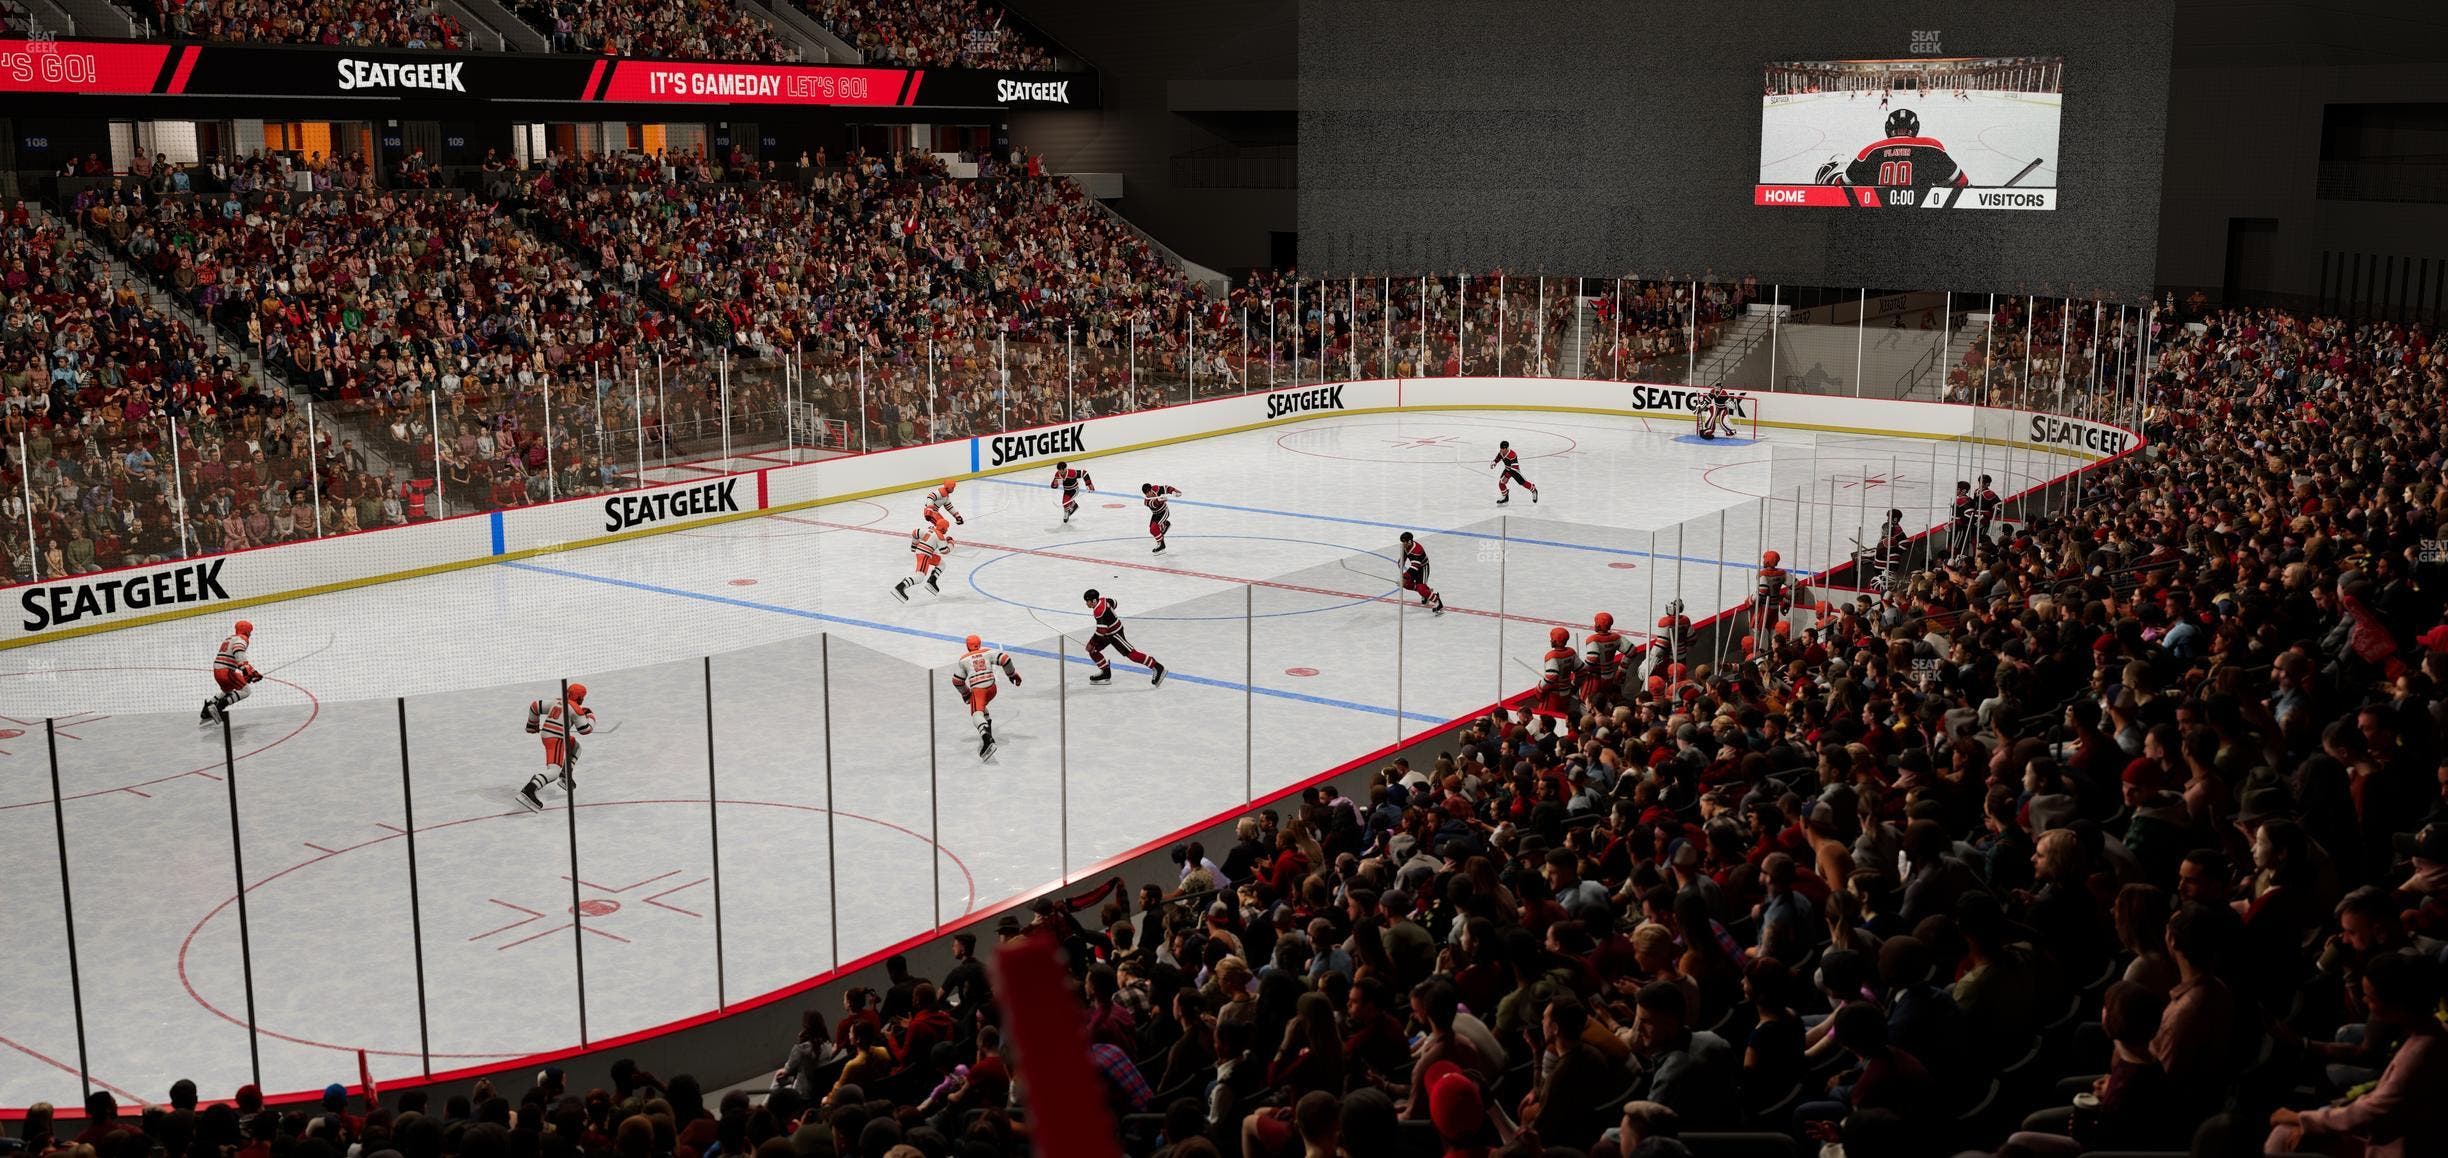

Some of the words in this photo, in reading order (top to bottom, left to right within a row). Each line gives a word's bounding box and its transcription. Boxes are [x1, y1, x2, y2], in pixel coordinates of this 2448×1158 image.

[41, 53, 96, 83] GO!
[337, 58, 466, 93] SEATGEEK
[650, 71, 687, 94] IT'S
[691, 73, 781, 96] GAMEDAY
[786, 75, 834, 97] LET'S
[837, 77, 868, 98] GO!
[997, 79, 1069, 104] SEATGEEK
[25, 138, 48, 148] 108
[384, 137, 401, 147] 108
[448, 137, 464, 147] 109
[1878, 161, 1913, 186] 00
[1765, 190, 1806, 203] HOME
[1864, 191, 1871, 205] 0
[1889, 189, 1915, 206] 0:00
[1933, 192, 1940, 205] 0
[1978, 193, 2045, 207] VISITORS
[1267, 385, 1344, 419] SEATGEEK
[1632, 385, 1747, 418] SEATGK
[991, 423, 1086, 466] SEATGEEK
[604, 477, 739, 532] SEATGEEK
[21, 558, 230, 632] SEATGEEK
